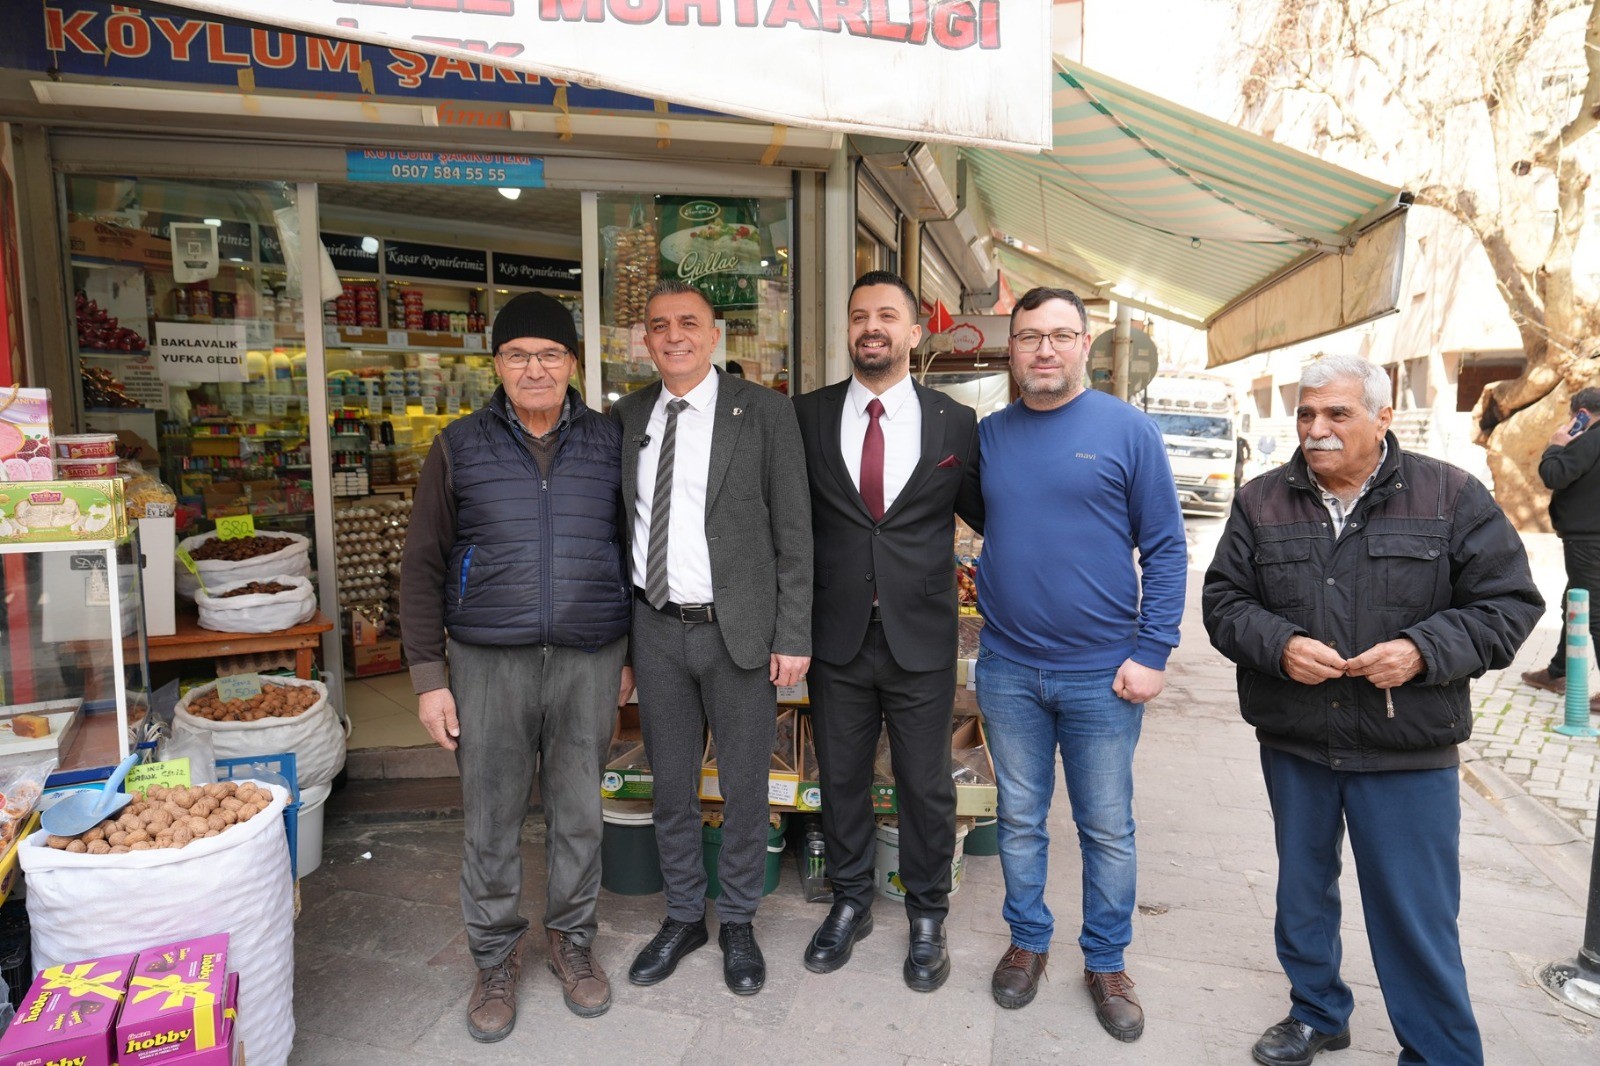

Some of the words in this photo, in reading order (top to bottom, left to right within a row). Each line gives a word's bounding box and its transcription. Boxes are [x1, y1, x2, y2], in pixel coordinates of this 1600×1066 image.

[392, 165, 428, 178] 0507
[434, 166, 461, 179] 584
[466, 167, 483, 180] 55
[488, 168, 506, 181] 55
[388, 250, 419, 266] Kaşar
[420, 254, 485, 272] Peynirlerimiz
[499, 262, 519, 277] Köy
[161, 338, 238, 349] BAKLAVALIK
[162, 353, 203, 364] YUFKA
[207, 352, 243, 365] GELDİ
[1075, 451, 1097, 461] mavi
[25, 991, 53, 1022] hobby
[124, 1028, 193, 1054] hobby
